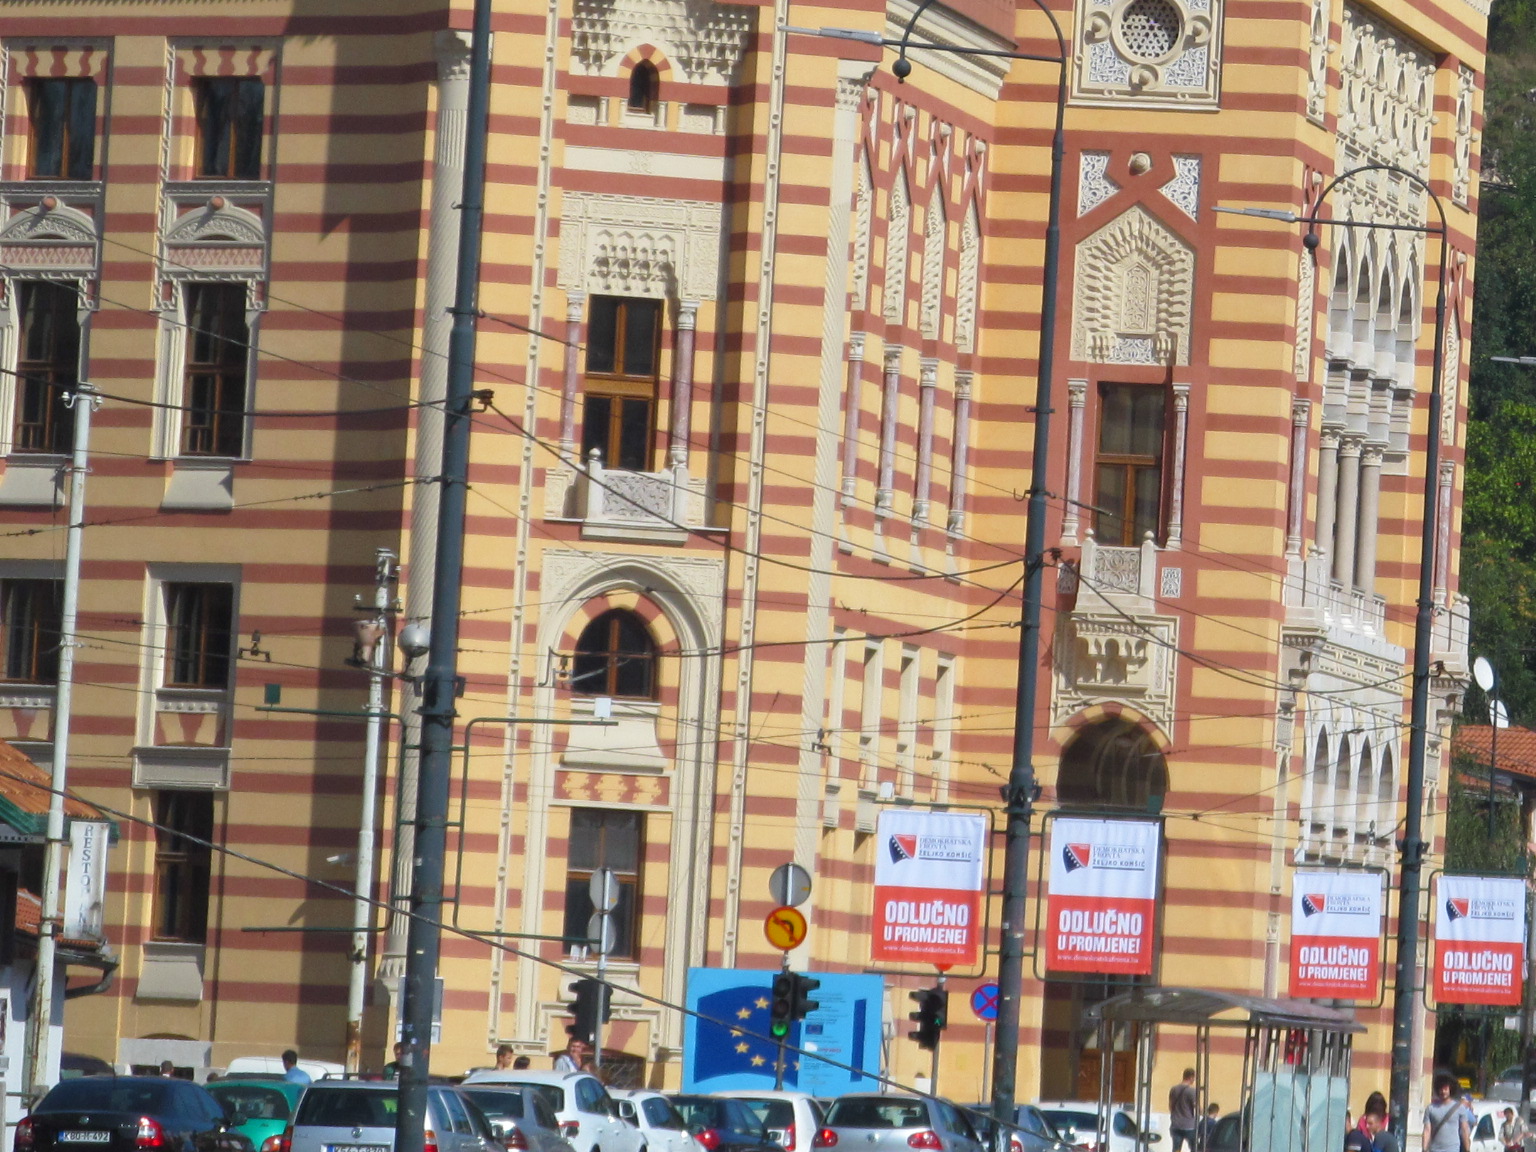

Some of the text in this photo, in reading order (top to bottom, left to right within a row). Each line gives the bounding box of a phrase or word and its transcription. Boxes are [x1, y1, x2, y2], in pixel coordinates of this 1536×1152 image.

[79, 824, 93, 925] RESTON
[885, 900, 969, 927] ODLUČNO
[1059, 909, 1143, 936] ODLUČNO
[883, 925, 967, 945] U PROMJENE!
[1058, 935, 1141, 954] U PROMJENE!
[1300, 945, 1369, 966] ODLUČNO
[1444, 951, 1513, 972] ODLUČNO
[1298, 966, 1368, 981] U PROMJENE!
[1443, 971, 1512, 986] U PROMJENE!
